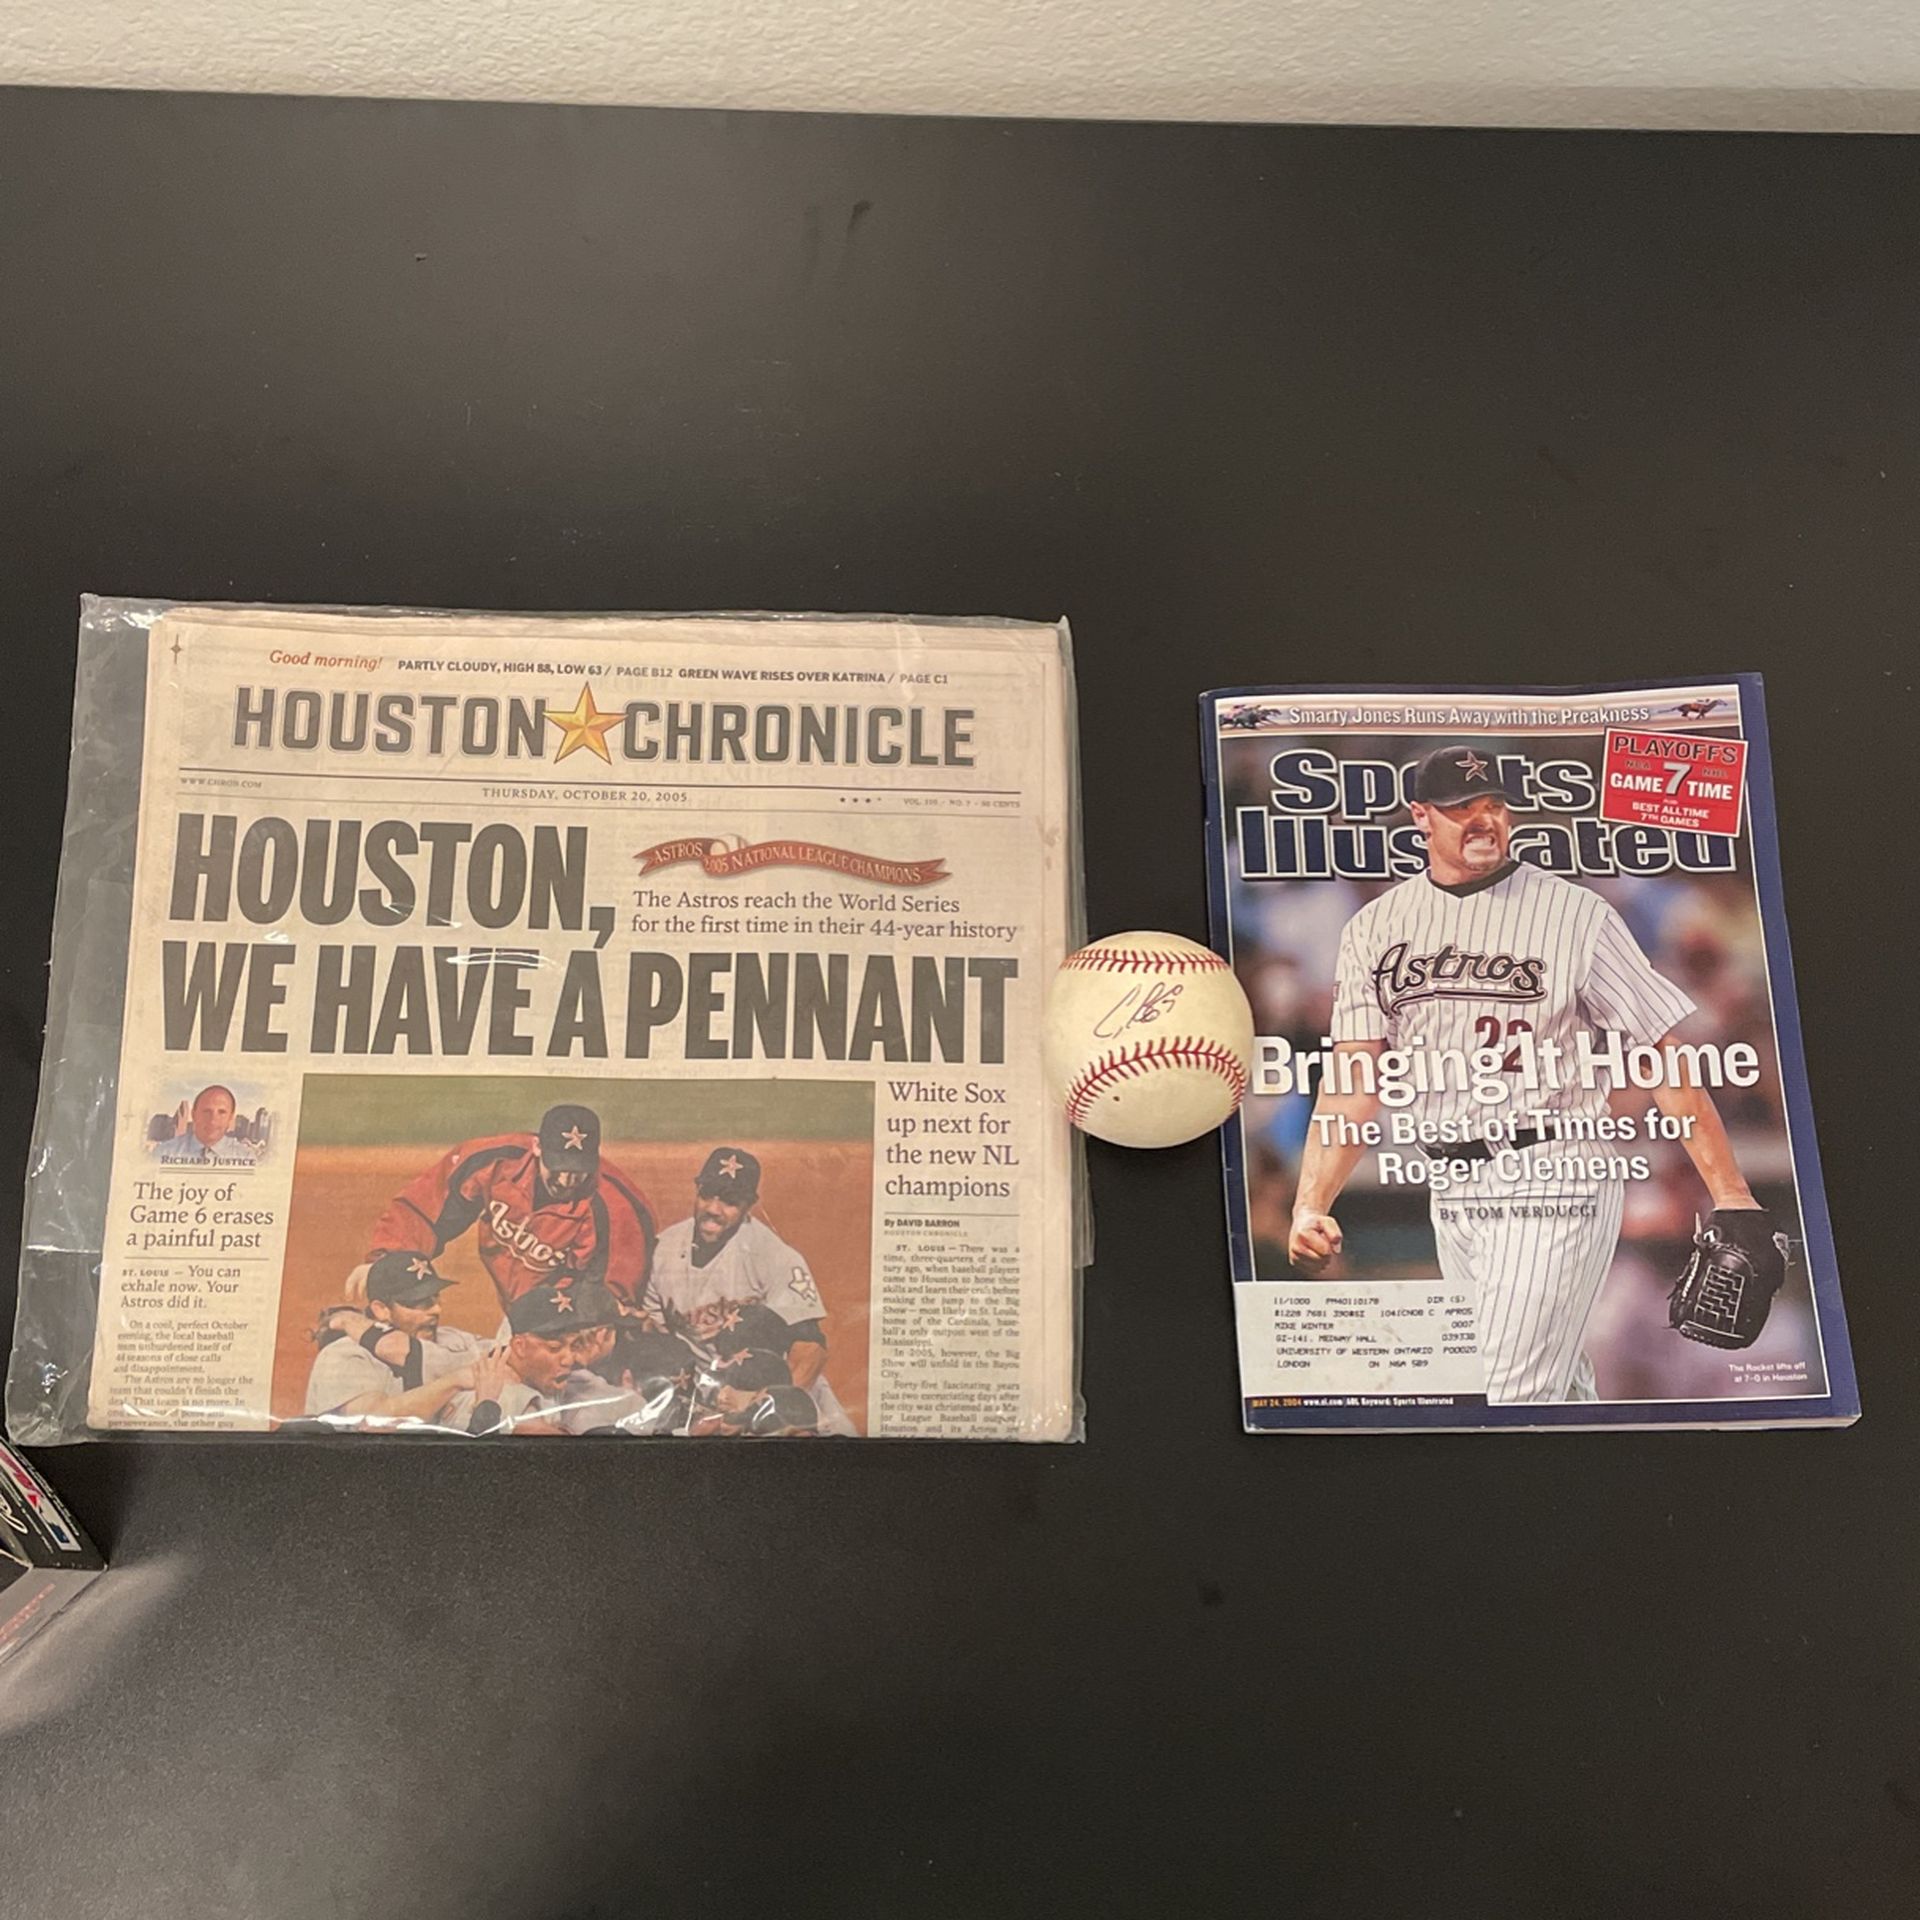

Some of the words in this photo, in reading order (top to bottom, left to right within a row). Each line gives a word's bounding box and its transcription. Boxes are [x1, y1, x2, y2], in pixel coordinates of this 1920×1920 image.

[269, 649, 310, 666] Good
[313, 654, 384, 673] morning!
[398, 660, 444, 672] PARTLY
[447, 661, 501, 675] CLOUDY,
[503, 662, 534, 673] HIGH
[536, 663, 555, 676] 88,
[557, 664, 585, 675] LOW
[588, 665, 602, 676] 63
[617, 667, 648, 678] PAGE
[651, 667, 673, 678] B12
[679, 668, 719, 679] GREEN
[722, 669, 757, 680] WAVE
[761, 670, 794, 681] RISES
[797, 671, 830, 682] OVER
[832, 671, 885, 683] KATRINA
[900, 674, 931, 684] PAGE
[933, 674, 948, 684] C1
[231, 686, 547, 758] HOUSTON
[622, 699, 977, 767] CHRONICLE
[1289, 707, 1348, 727] Smarty
[1351, 707, 1401, 725] Jones
[1404, 707, 1445, 725] Runs
[1449, 707, 1490, 728] Away
[1494, 708, 1530, 726] with
[1532, 708, 1558, 725] the
[1560, 706, 1650, 726] Preakness
[1613, 735, 1738, 766] PLAYOFFS
[1270, 749, 1597, 820] Spts
[1610, 772, 1664, 793] GAME
[1663, 762, 1692, 797] 7
[1687, 780, 1734, 801] TIME
[482, 787, 557, 801] THURSDAY,
[562, 789, 627, 802] OCTOBER
[631, 790, 650, 805] 20,
[655, 791, 688, 803] 2005
[1632, 801, 1660, 813] BEST
[1660, 815, 1701, 828] GAMES
[1236, 805, 1738, 882] Illusated
[653, 842, 704, 865] ASTROS
[731, 845, 796, 871] NATIONAL
[798, 847, 850, 869] LEAGUE
[850, 858, 922, 883] CHAMPIONS
[169, 813, 616, 949] HOUSTON,
[633, 890, 671, 909] The
[676, 891, 739, 910] Astros
[744, 891, 797, 910] reach
[802, 891, 833, 910] the
[838, 893, 896, 912] World
[902, 895, 960, 914] Series
[631, 915, 659, 933] for
[665, 915, 696, 934] the
[700, 915, 741, 934] first
[746, 916, 789, 935] time
[794, 917, 814, 935] in
[818, 916, 864, 936] their
[869, 919, 944, 941] 44-year
[949, 920, 1018, 943] history
[1372, 941, 1547, 1019] Astros
[162, 940, 297, 1053] WE
[310, 944, 541, 1056] HAVE
[546, 950, 609, 1059] A
[624, 952, 1019, 1064] PENNANT
[1252, 1035, 1510, 1109] Bringing
[1519, 1030, 1563, 1090] It
[1579, 1030, 1761, 1092] Home
[888, 1081, 958, 1103] White
[965, 1082, 1007, 1104] Sox
[887, 1116, 917, 1138] up
[922, 1115, 973, 1134] next
[979, 1112, 1012, 1135] for
[1311, 1113, 1381, 1147] The
[1392, 1112, 1473, 1146] Best
[1481, 1110, 1519, 1143] of
[1527, 1109, 1637, 1143] Times
[1643, 1107, 1697, 1142] for
[886, 1142, 922, 1164] the
[929, 1149, 977, 1165] new
[982, 1144, 1020, 1165] NL
[1379, 1151, 1486, 1191] Roger
[1498, 1146, 1651, 1182] Clemens
[133, 1181, 173, 1200] The
[178, 1182, 210, 1205] joy
[214, 1182, 237, 1202] of
[885, 1174, 1011, 1202] champions
[130, 1204, 189, 1225] Game
[195, 1207, 207, 1225] 6
[213, 1211, 275, 1226] erases
[884, 1218, 895, 1228] By
[897, 1219, 923, 1227] DAVID
[925, 1219, 960, 1228] BARRON
[1439, 1207, 1458, 1222] By
[1464, 1206, 1505, 1219] TOM
[1510, 1204, 1598, 1219] VERDUCCI
[126, 1233, 137, 1246] a
[143, 1228, 215, 1251] painful
[220, 1232, 262, 1252] past
[188, 1264, 213, 1278] You
[217, 1268, 241, 1278] can
[121, 1279, 165, 1293] exhale
[169, 1282, 202, 1293] now.
[207, 1280, 239, 1293] Your
[121, 1295, 164, 1309] Astros
[167, 1295, 190, 1309] did
[193, 1295, 208, 1309] it.
